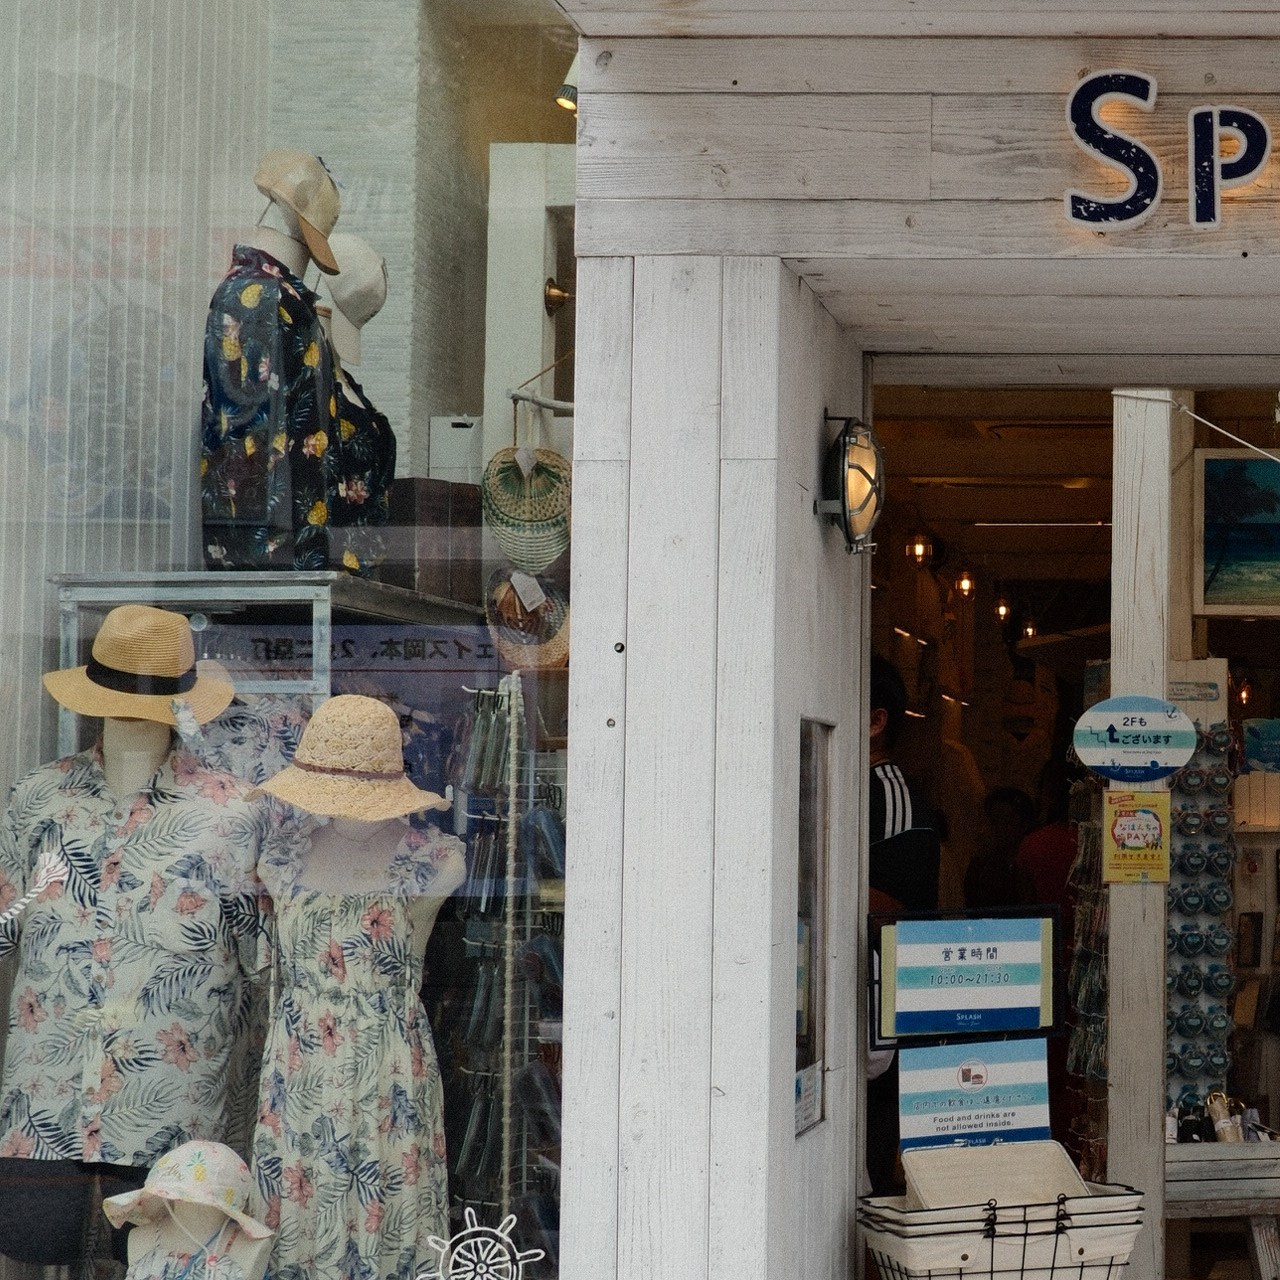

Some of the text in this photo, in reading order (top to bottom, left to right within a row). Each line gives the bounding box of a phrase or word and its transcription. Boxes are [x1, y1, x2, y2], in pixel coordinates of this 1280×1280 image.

[1122, 716, 1147, 727] 2Fも
[1121, 734, 1172, 745] ございます
[1127, 833, 1148, 841] PAY
[942, 946, 998, 961] 営業時間
[956, 1013, 982, 1021] SPLASH
[956, 1114, 972, 1122] and
[974, 1112, 1000, 1120] drinks
[936, 1120, 1014, 1132] not allowed inside.
